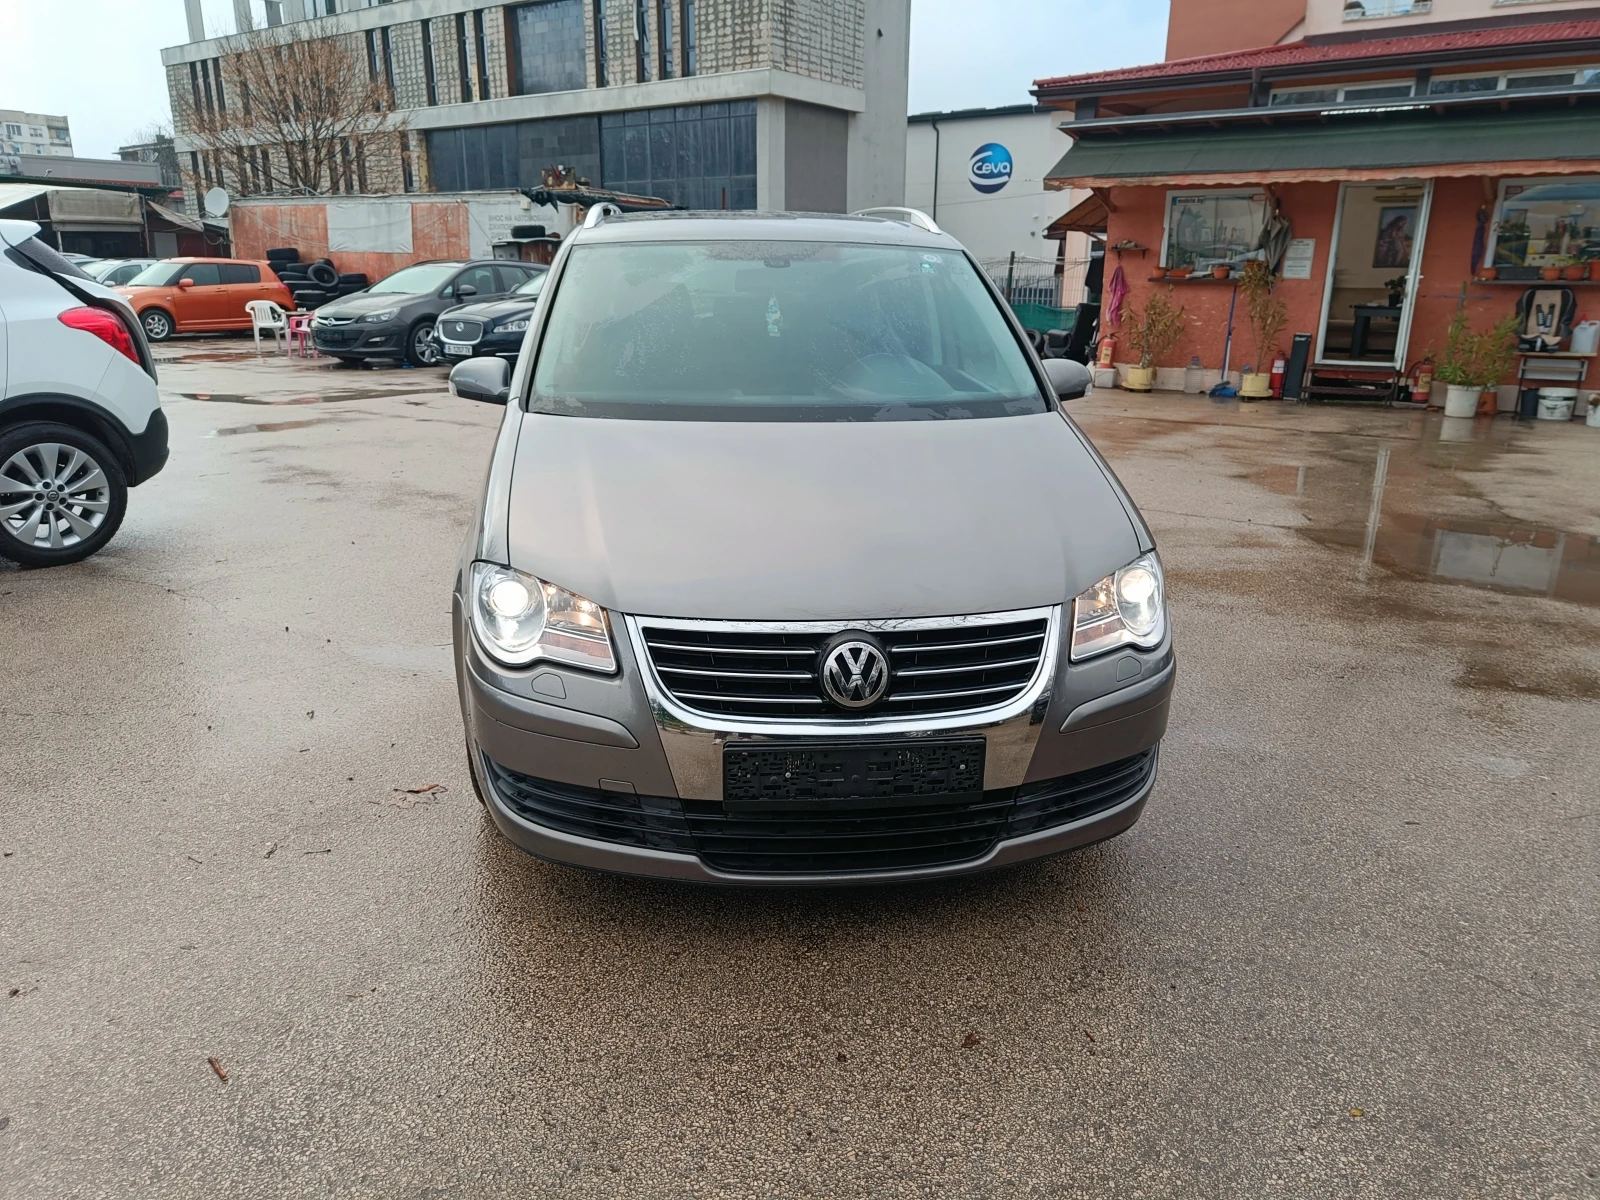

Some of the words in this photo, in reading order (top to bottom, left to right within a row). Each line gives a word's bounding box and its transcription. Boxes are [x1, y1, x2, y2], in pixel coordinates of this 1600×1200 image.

[973, 161, 1011, 174] ceva
[488, 214, 504, 222] ВНОС
[505, 214, 512, 222] НА
